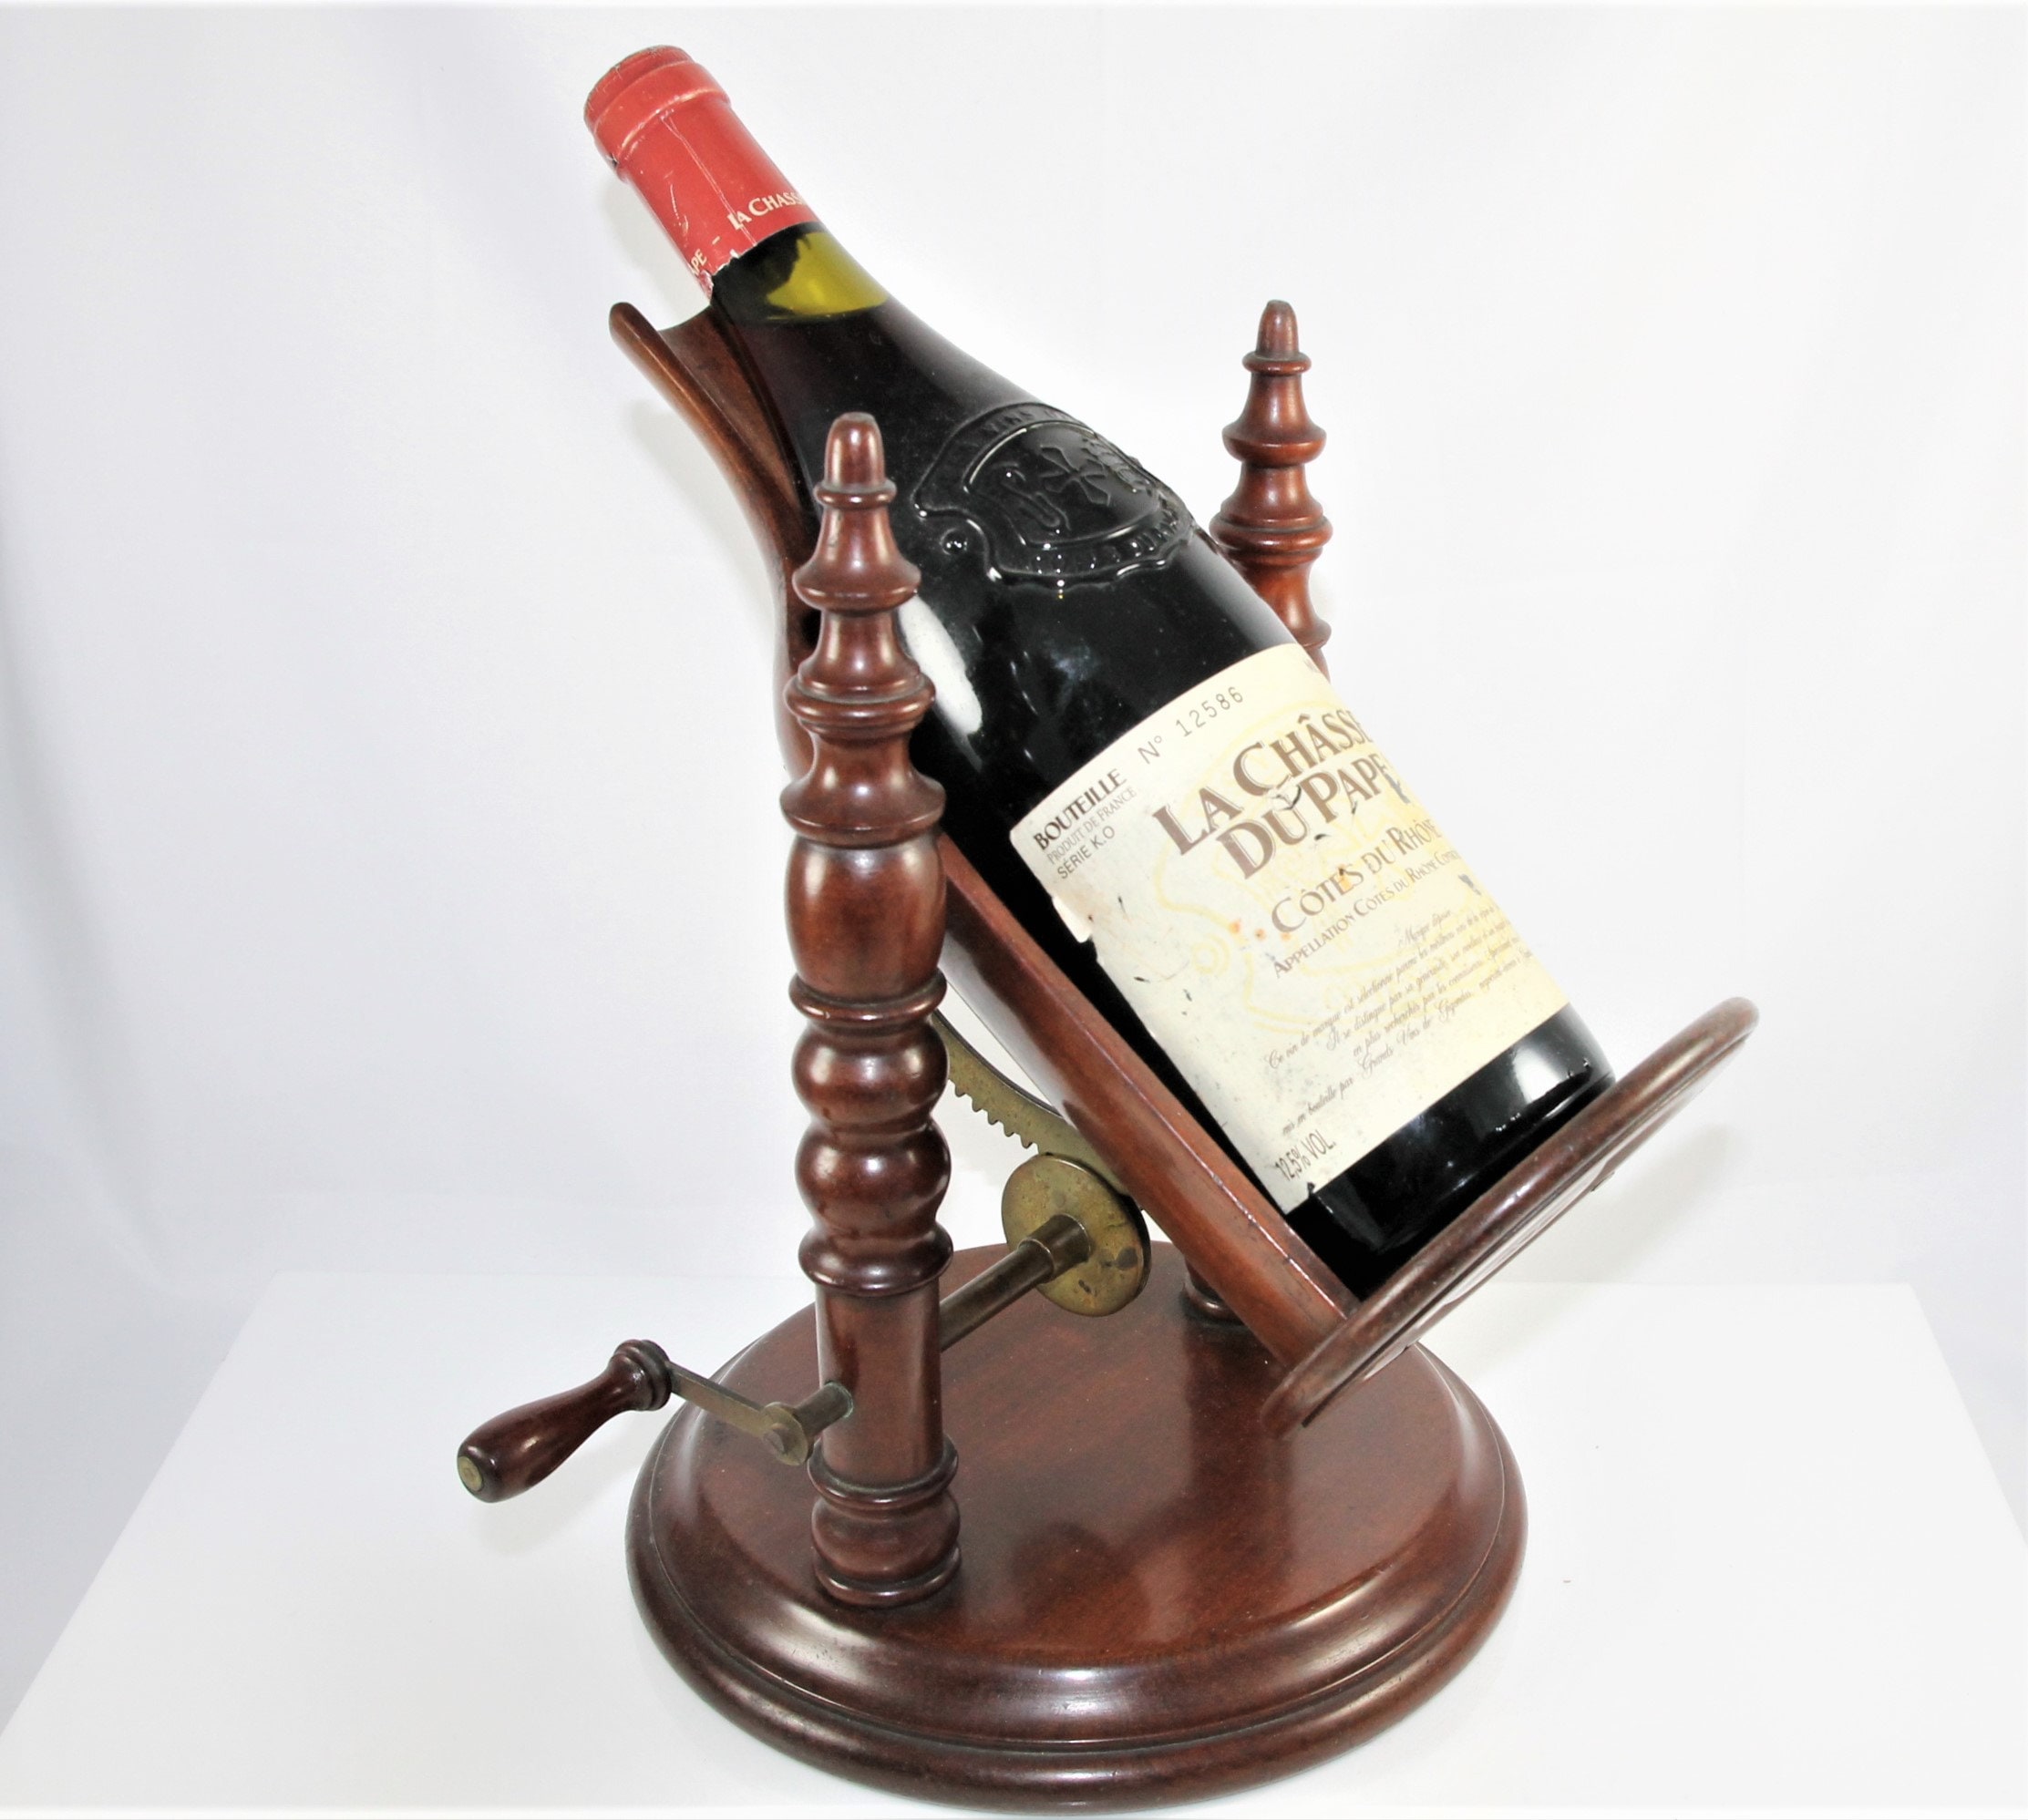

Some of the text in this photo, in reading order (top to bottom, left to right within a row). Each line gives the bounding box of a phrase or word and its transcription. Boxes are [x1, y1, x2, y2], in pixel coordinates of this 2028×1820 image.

[727, 211, 753, 231] LA
[1175, 686, 1244, 738] 12586
[1033, 768, 1128, 851] BOUTEILLE
[1046, 787, 1138, 866] PRODUIT DE FRANCE
[1152, 787, 1245, 857] LA
[1057, 845, 1093, 879] SÉRIE
[1215, 802, 1312, 880] DU
[1271, 865, 1364, 933] CÔTES
[1361, 839, 1397, 875] DU
[1272, 913, 1356, 979] APPELLATION
[1354, 888, 1395, 917] CÔTES
[1393, 878, 1410, 892] DU
[1389, 992, 1402, 1012] par
[1423, 992, 1435, 1013] par
[1286, 1043, 1298, 1057] vin
[1340, 1077, 1354, 1099] par
